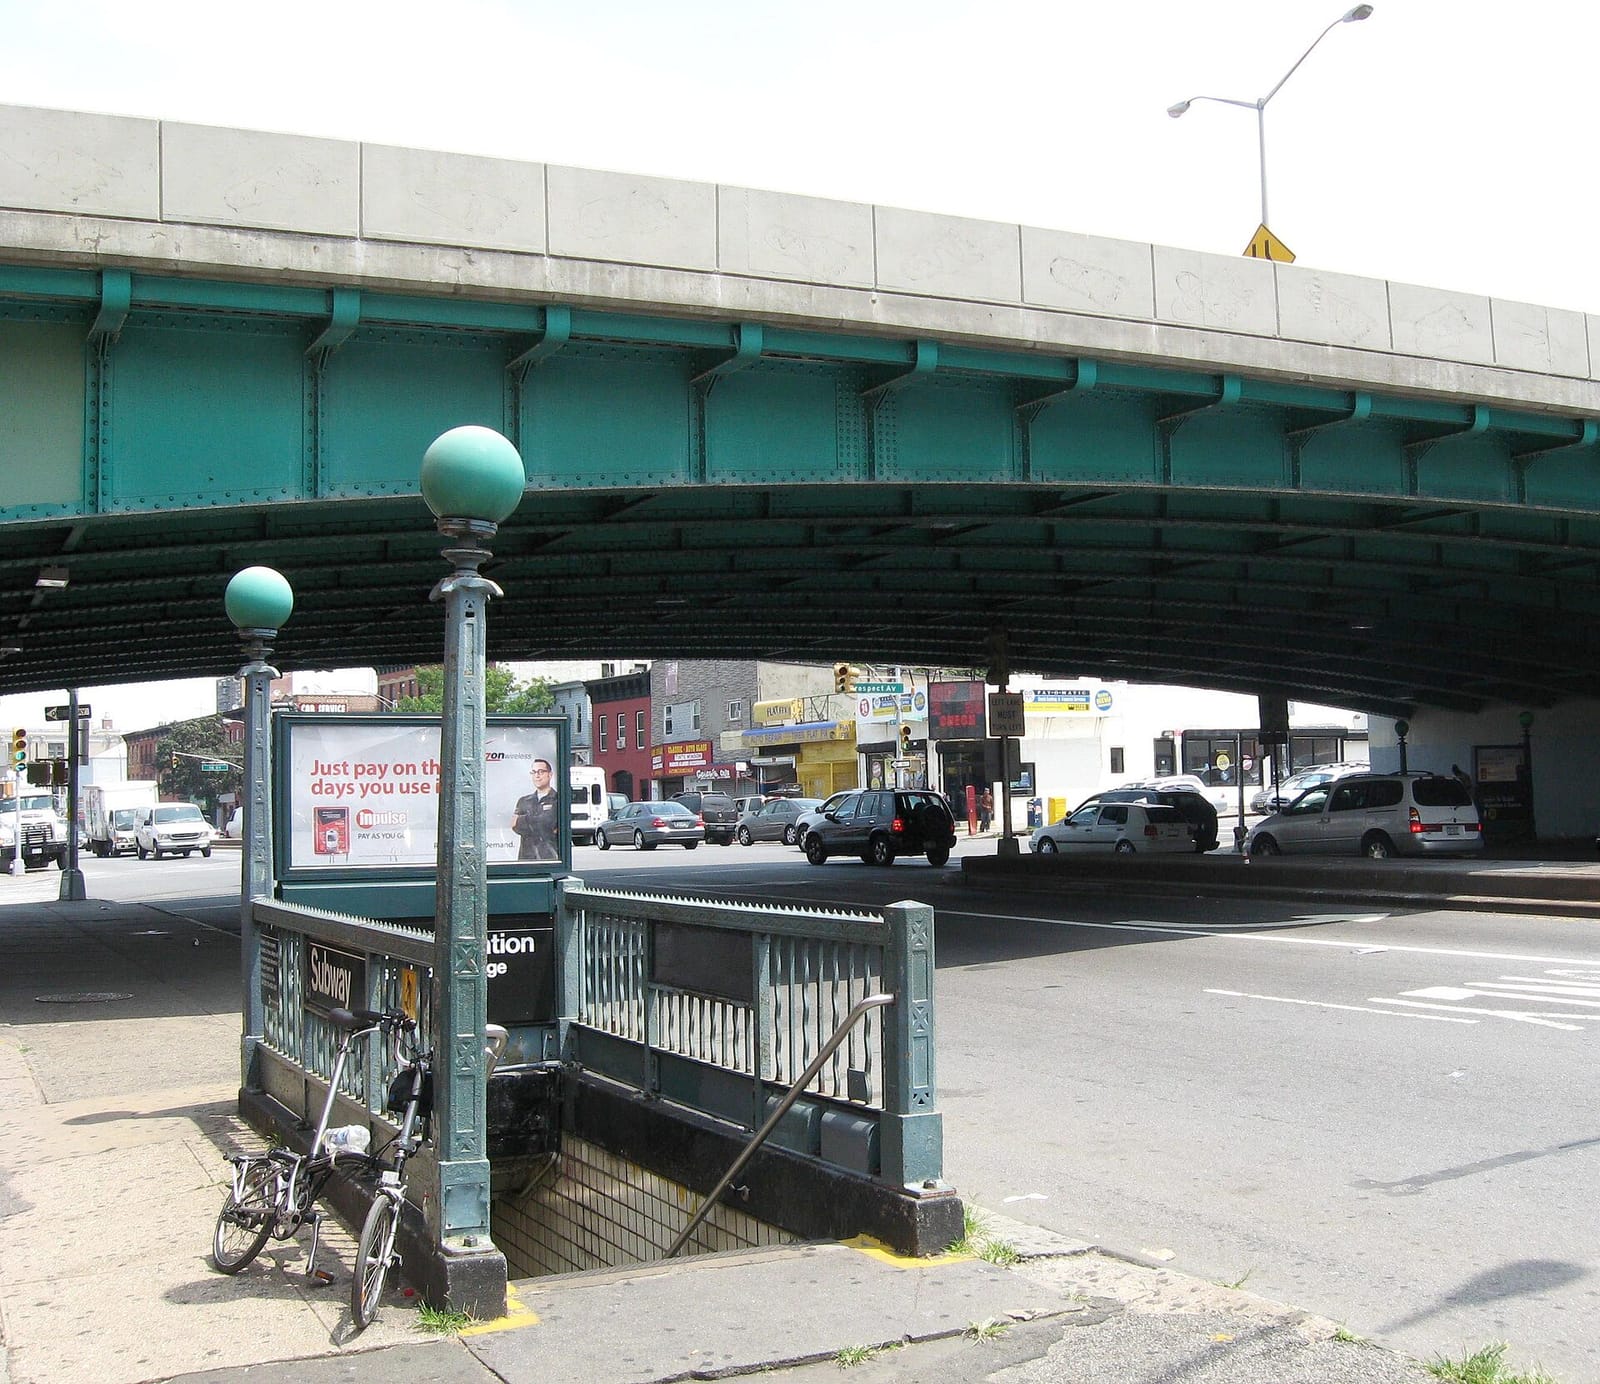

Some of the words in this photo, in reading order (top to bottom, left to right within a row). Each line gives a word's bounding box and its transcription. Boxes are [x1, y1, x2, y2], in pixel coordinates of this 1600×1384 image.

[301, 704, 315, 712] CAR
[318, 704, 346, 712] SERVICE
[310, 759, 349, 776] Just
[354, 763, 388, 780] pay
[393, 763, 417, 776] on
[421, 759, 441, 776] th
[311, 778, 355, 799] days
[360, 782, 394, 799] you
[399, 782, 431, 794] use
[357, 832, 371, 840] PAY
[371, 832, 381, 840] AS
[487, 932, 535, 954] tion
[311, 946, 352, 1010] Subway
